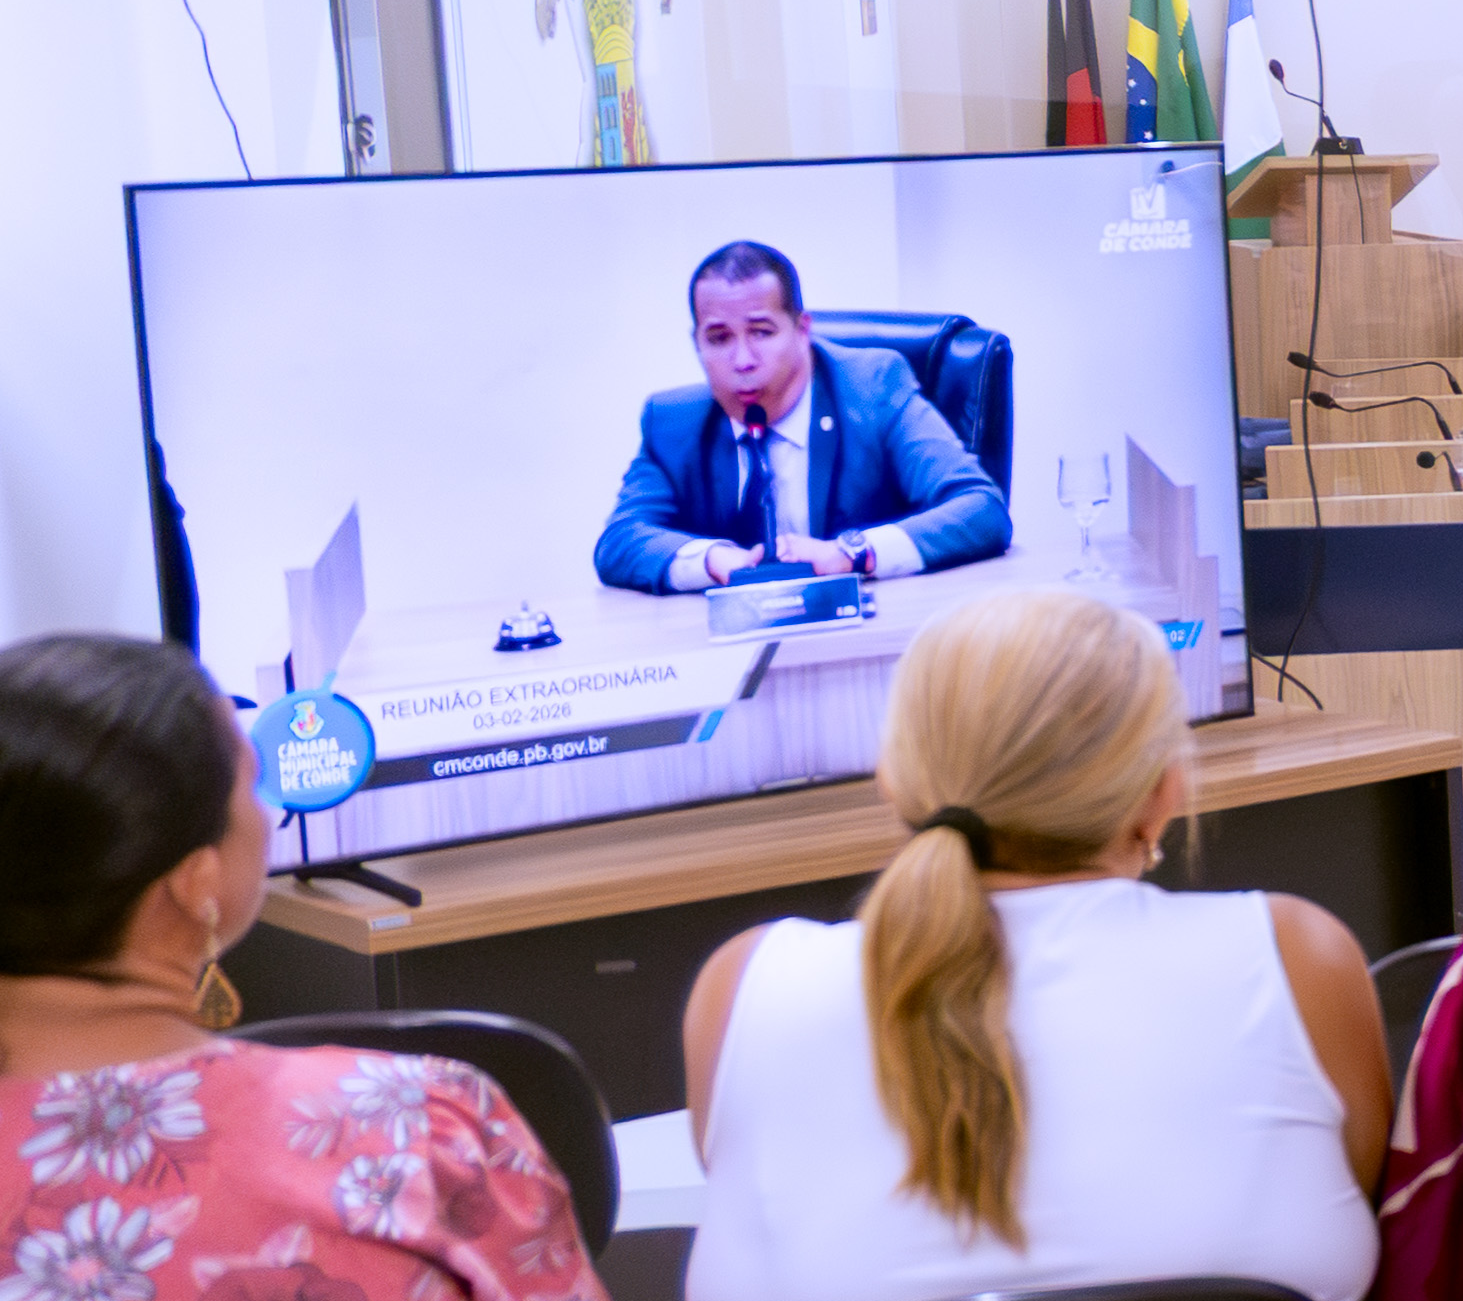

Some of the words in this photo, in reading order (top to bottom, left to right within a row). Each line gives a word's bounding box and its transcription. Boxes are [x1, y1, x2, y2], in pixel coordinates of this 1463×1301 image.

[381, 689, 482, 721] REUNIÃO
[490, 665, 678, 707] EXTRAORDINÁRIA
[473, 703, 572, 730] 03-02-2026
[278, 737, 339, 760] CÂMARA
[279, 750, 357, 774] MUNICIPAL
[433, 735, 609, 777] cmconde.pb.gov.br
[281, 773, 300, 793] DE
[302, 766, 351, 789] CONDE
